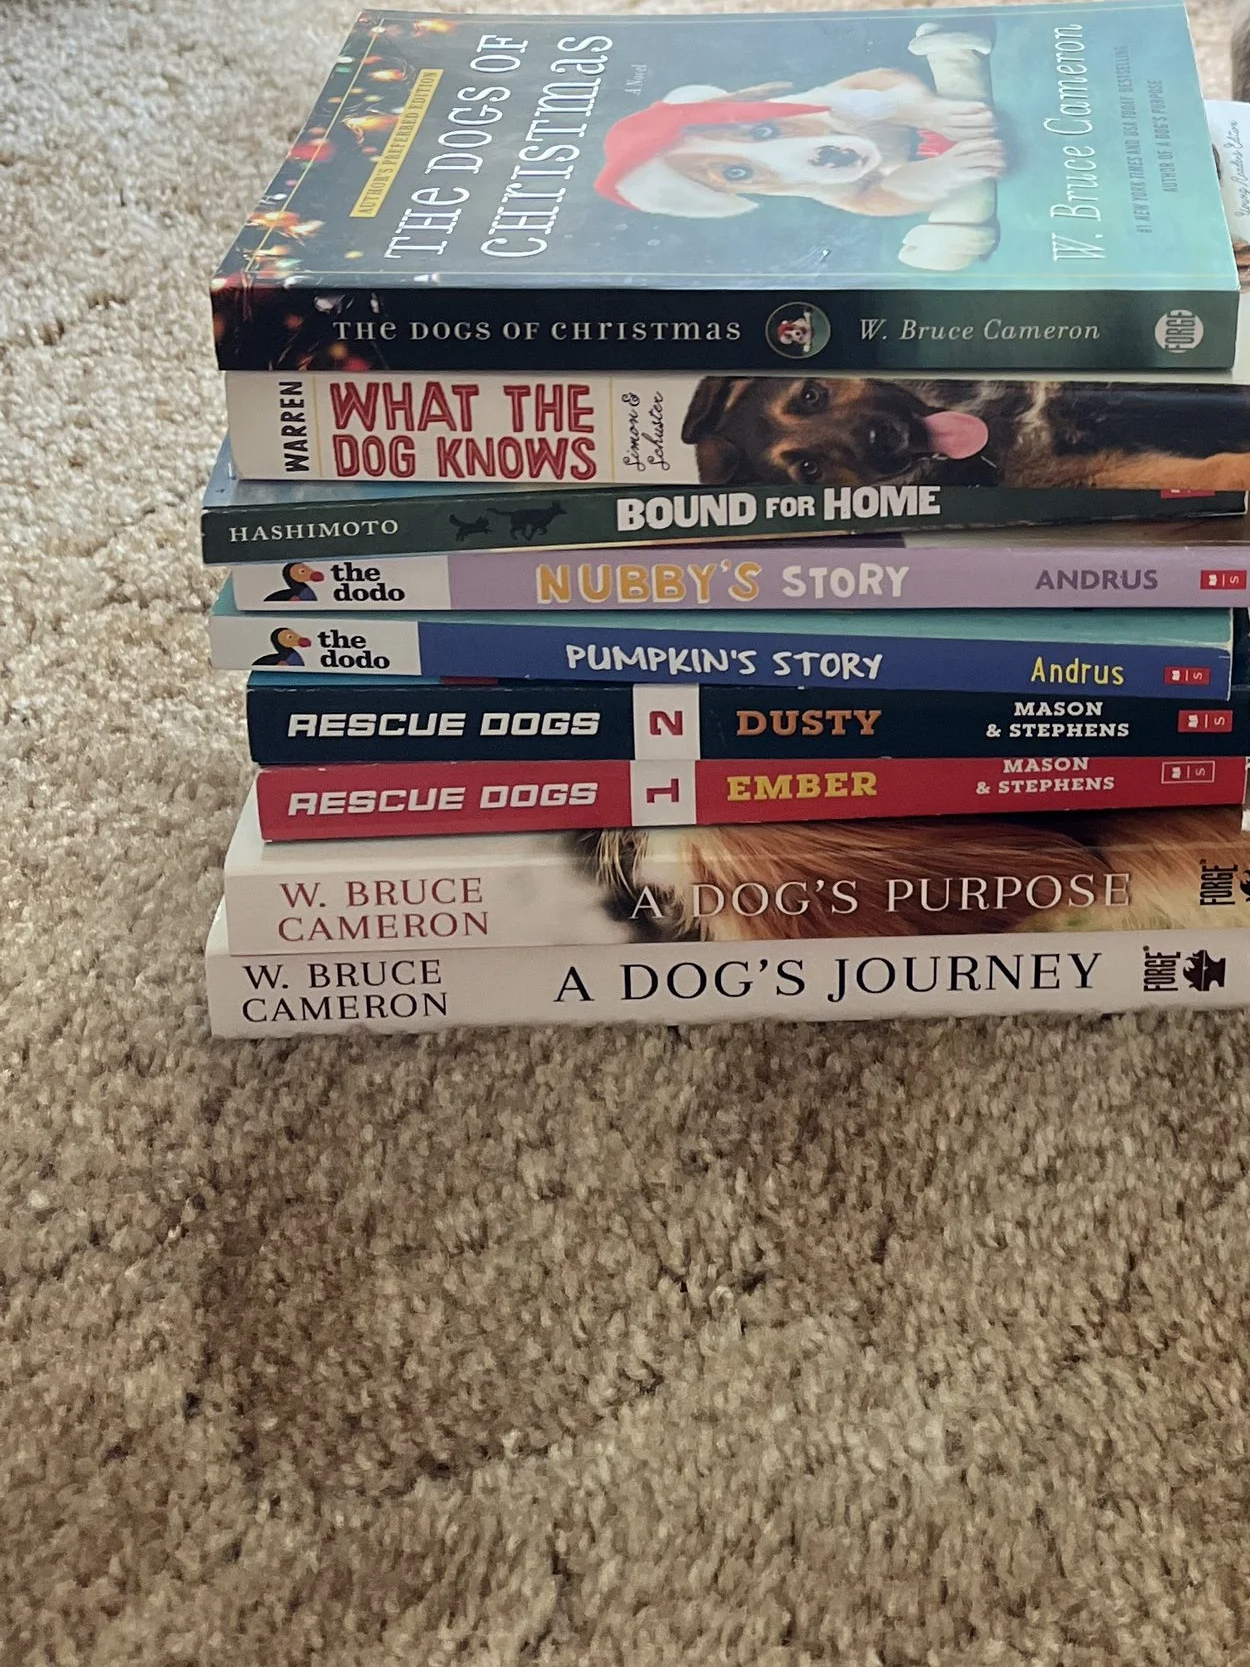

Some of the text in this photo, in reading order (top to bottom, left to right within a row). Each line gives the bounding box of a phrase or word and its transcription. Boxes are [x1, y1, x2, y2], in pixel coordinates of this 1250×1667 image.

[625, 64, 648, 86] Novel
[1113, 45, 1134, 92] BESTSELLING
[425, 85, 511, 174] DOGS
[470, 34, 529, 73] OF
[1118, 94, 1138, 121] TODAY
[1147, 80, 1167, 114] PURPOSE
[358, 70, 438, 215] AUTHOR'S PREFERRED EDITION
[1043, 23, 1107, 262] W. Bruce Cameron
[1121, 121, 1139, 138] USA
[1151, 115, 1171, 140] DOG'S
[1223, 119, 1243, 150] Edition
[1124, 139, 1142, 156] AND
[1156, 148, 1174, 161] OF
[1127, 156, 1146, 178] TIMES
[1158, 162, 1178, 193] AUTHOR
[1130, 178, 1149, 202] YORK
[1133, 202, 1151, 222] NEW
[408, 320, 491, 341] DOGS
[502, 320, 539, 340] OF
[860, 317, 1101, 341] W. Bruce Cameron
[1164, 309, 1197, 353] FORGE
[330, 381, 595, 433] WHAT THE
[278, 380, 311, 473] WARREN
[622, 408, 646, 472] Simon
[647, 390, 671, 471] Schuster
[333, 434, 597, 480] DOG KNOWS
[616, 485, 941, 532] BOUND FOR HOME
[228, 519, 399, 543] HASHIMOTO
[330, 561, 381, 583] the
[536, 558, 910, 604] NUBBY'S STORY
[1035, 569, 1159, 591] ANDRUS
[333, 582, 405, 602] dodo
[317, 629, 367, 650] the
[320, 649, 391, 670] dodo
[565, 644, 883, 680] PUMPKIN'S STORY
[1030, 656, 1125, 686] Andrus
[649, 709, 683, 736] 2
[736, 709, 882, 736] DUSTY
[1013, 700, 1104, 717] MASON
[288, 712, 600, 738] RESCUE DOGS
[985, 722, 1130, 739] & STEPHENS
[1002, 756, 1090, 774] MASON
[288, 782, 598, 816] RESCUE DOGS
[646, 778, 679, 804] 1
[726, 771, 878, 802] EMBER
[976, 776, 1115, 795] & STEPHENS
[279, 876, 485, 909] W. BRUCE
[627, 873, 1131, 920] A DOG'S PURPOSE
[1199, 863, 1239, 907] FORGE
[277, 910, 490, 943] CAMERON
[242, 959, 442, 990] W. BRUCE
[553, 952, 1103, 1003] A DOG'S JOURNEY
[1143, 950, 1181, 992] FORGE
[241, 992, 449, 1023] CAMERON
